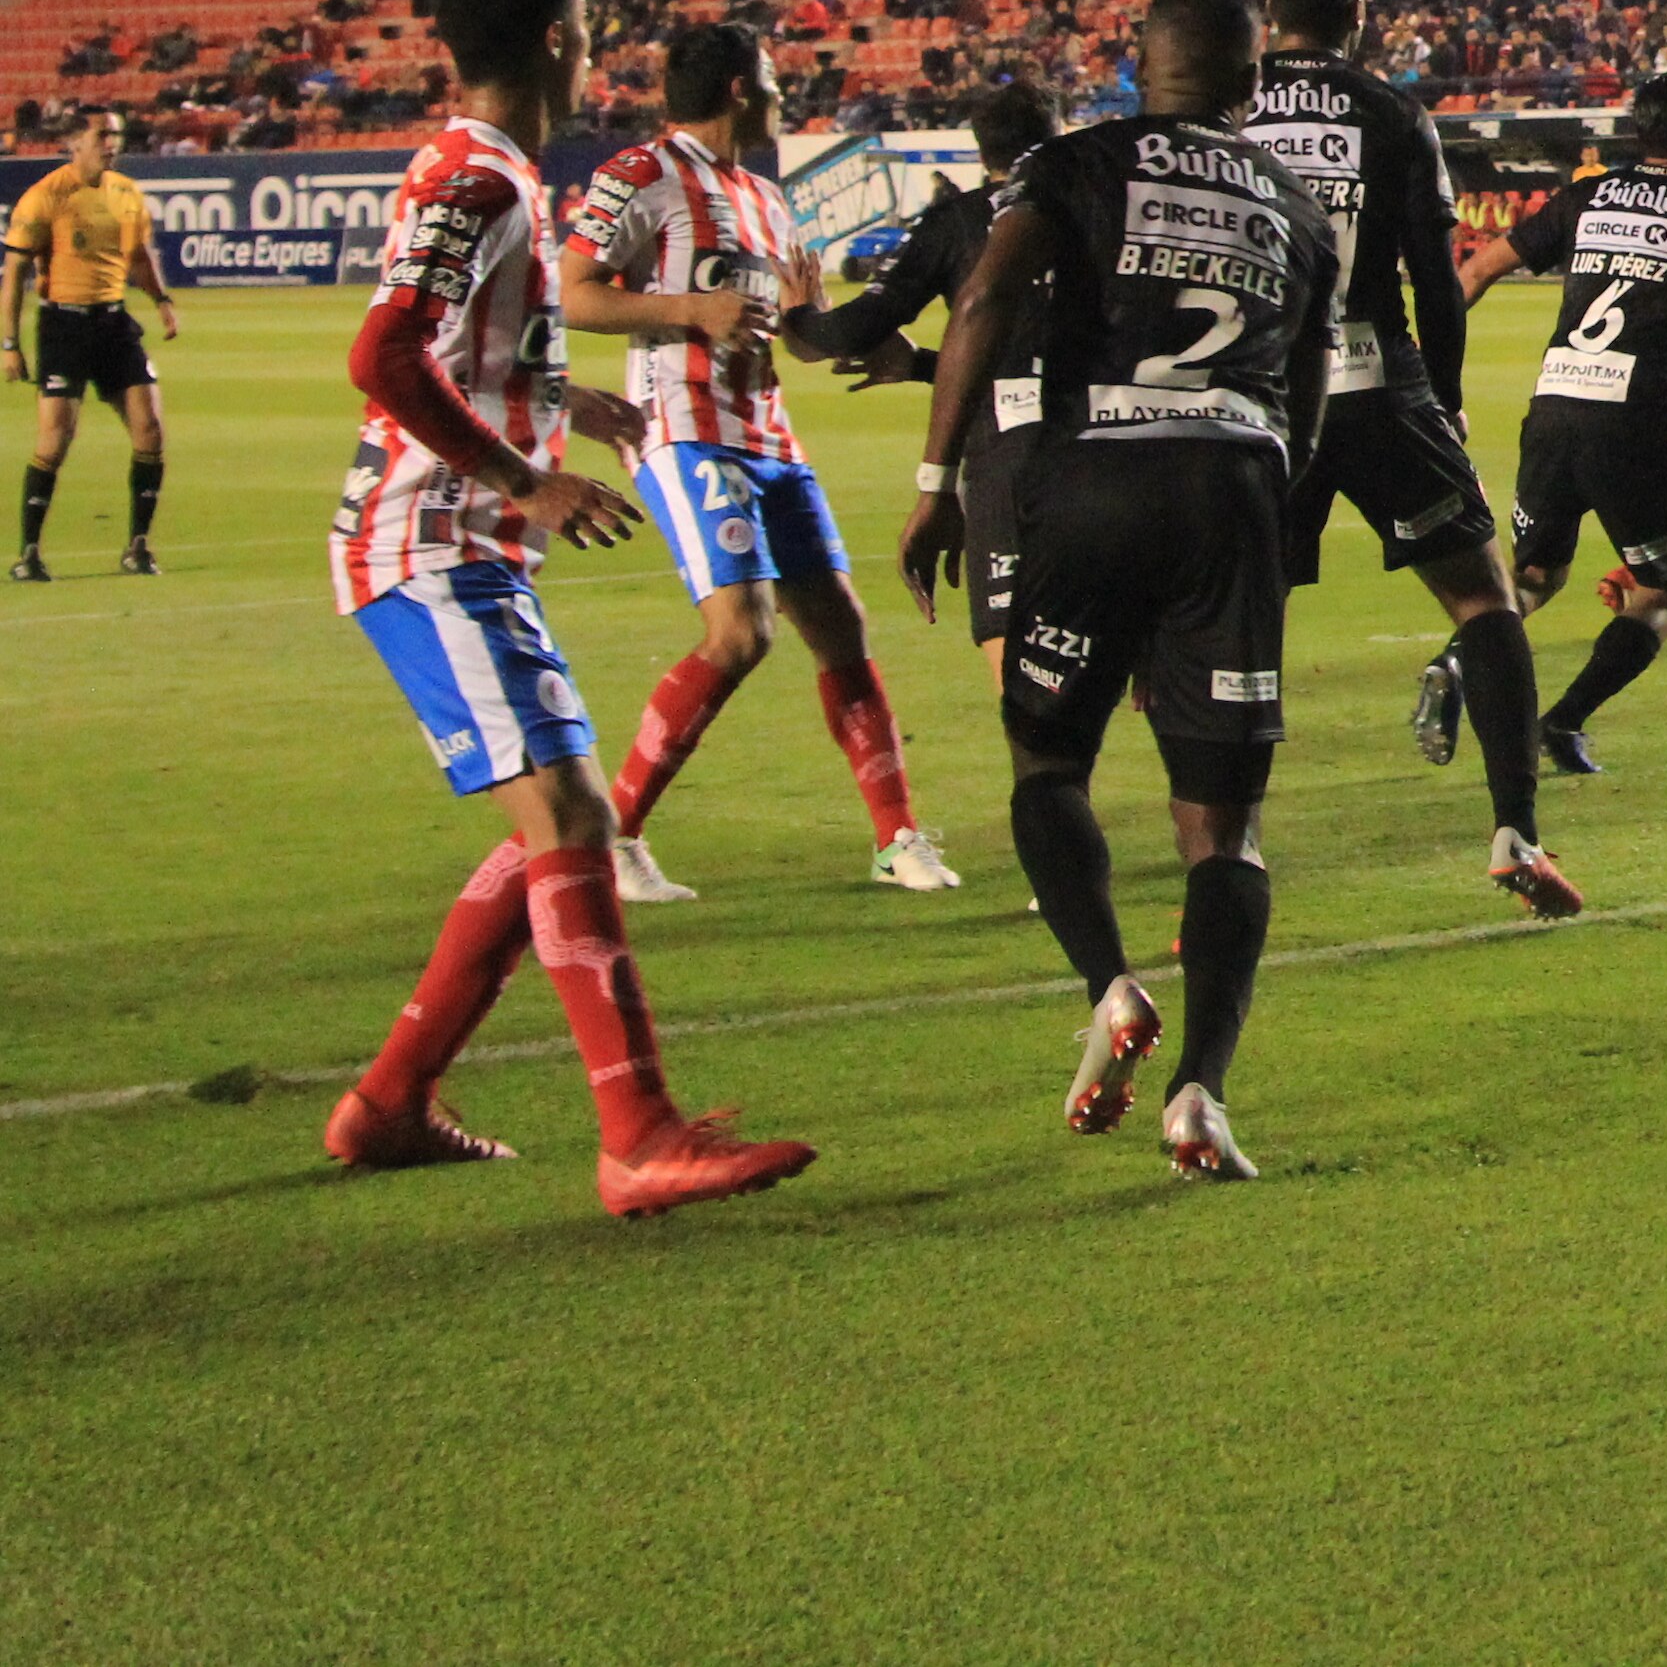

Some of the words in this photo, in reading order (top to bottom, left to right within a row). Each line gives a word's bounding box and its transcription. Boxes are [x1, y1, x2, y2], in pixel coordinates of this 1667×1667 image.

[1135, 133, 1278, 201] Búfalo
[1141, 199, 1238, 232] CIRCLE
[1584, 221, 1642, 239] CIRCLE
[179, 234, 249, 268] Office
[253, 237, 332, 274] Expres
[1570, 252, 1607, 275] LUIS
[1116, 243, 1286, 307] B.BECKELES
[1568, 279, 1636, 355] 6
[1133, 288, 1246, 390] 2
[1018, 657, 1065, 691] CHARLY
